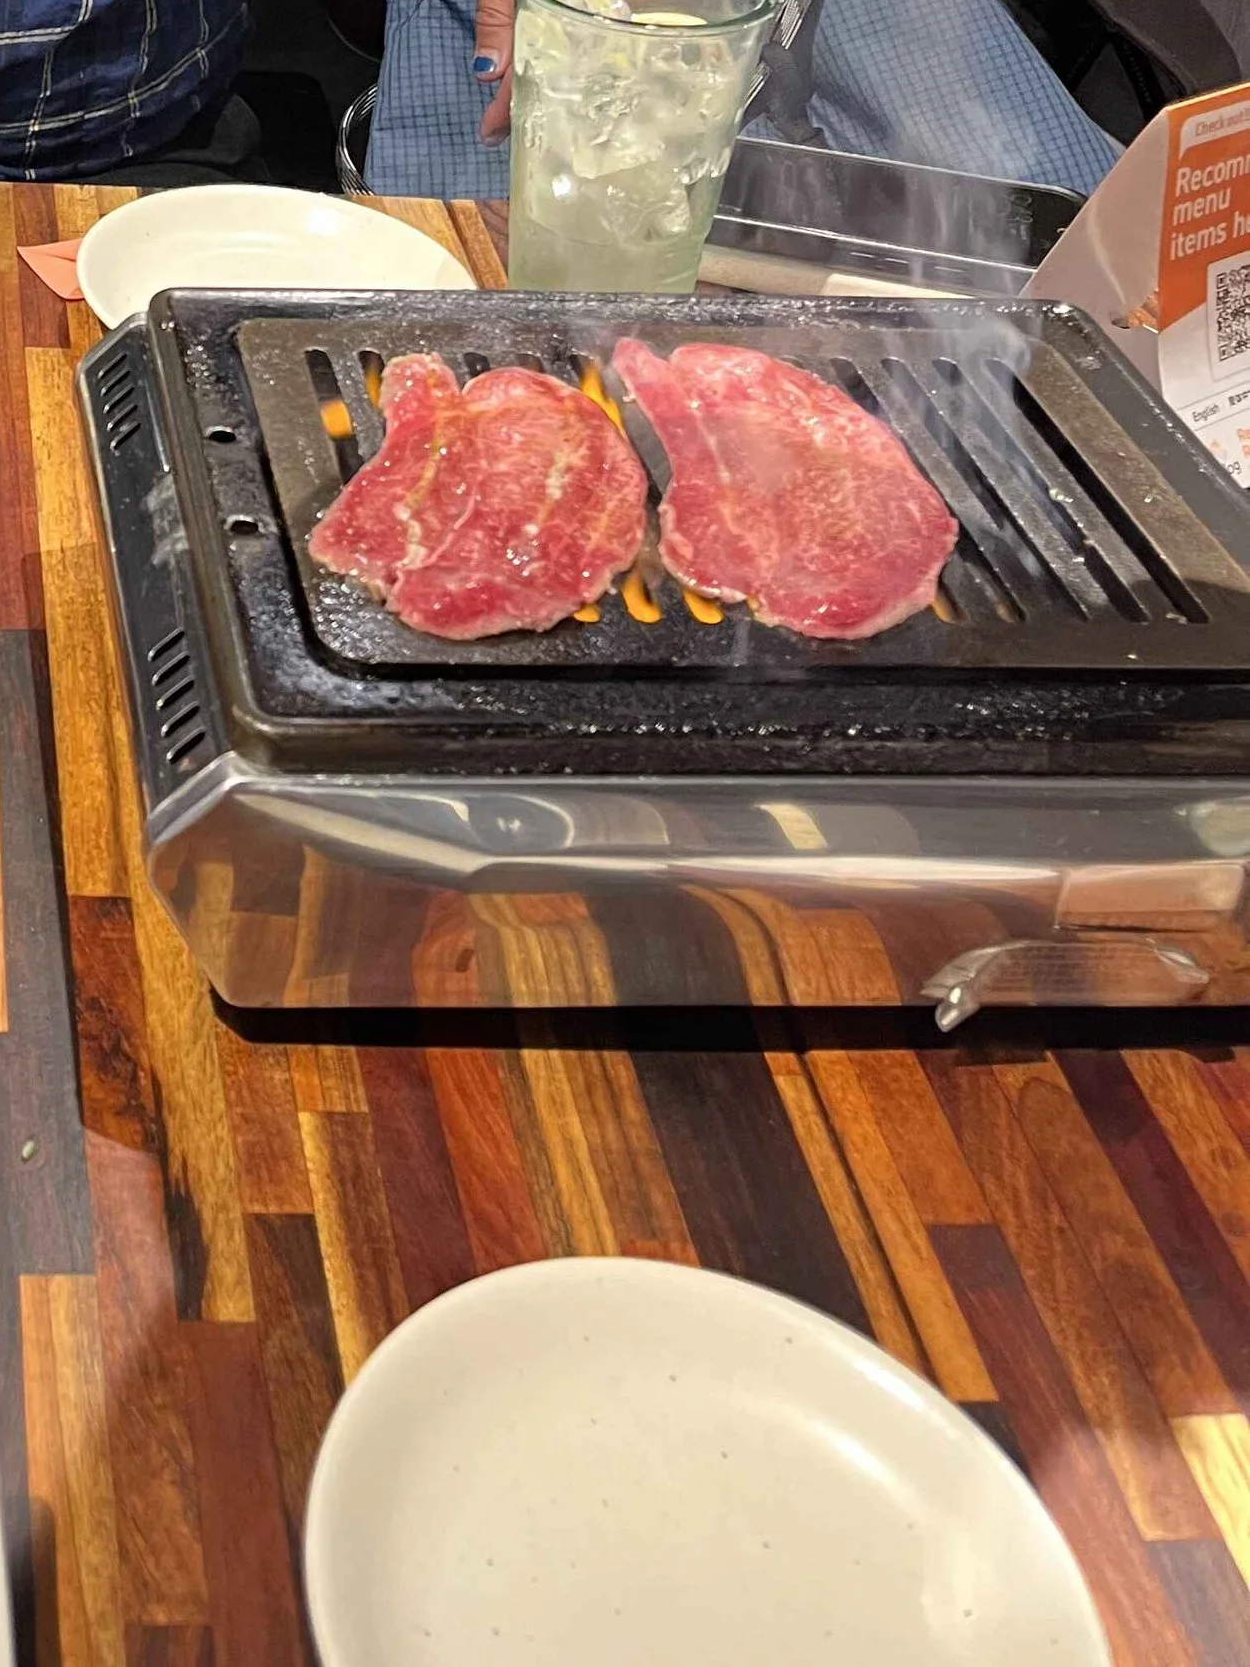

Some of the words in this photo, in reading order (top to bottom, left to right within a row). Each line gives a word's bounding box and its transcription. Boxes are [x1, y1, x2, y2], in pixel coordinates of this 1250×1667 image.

[1195, 114, 1224, 137] Check
[1172, 187, 1231, 227] menu
[1170, 222, 1227, 261] items
[1192, 404, 1220, 423] English
